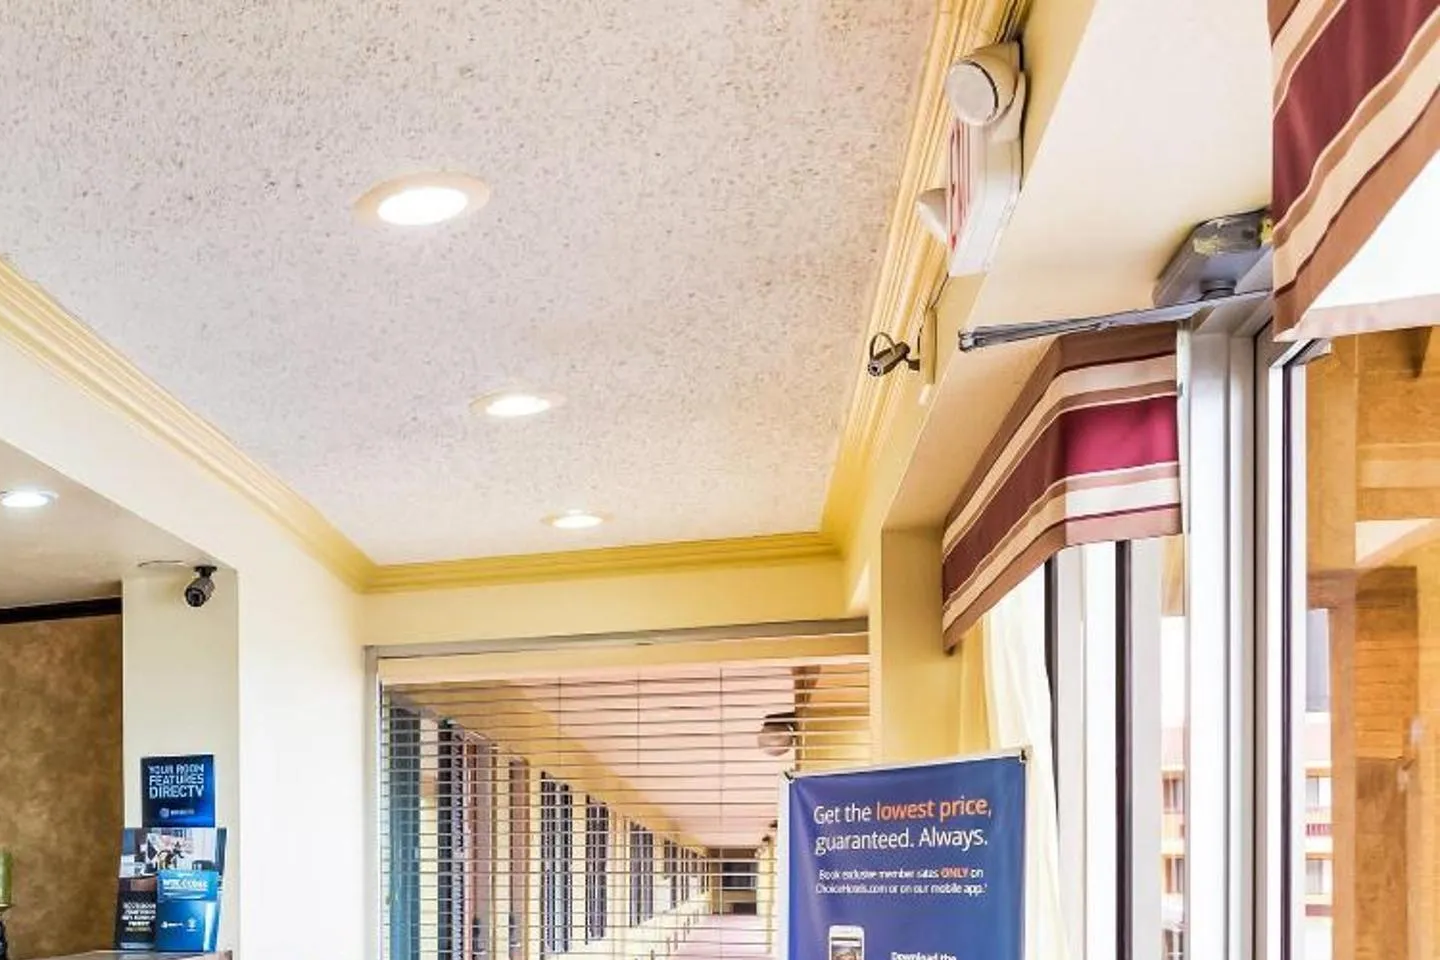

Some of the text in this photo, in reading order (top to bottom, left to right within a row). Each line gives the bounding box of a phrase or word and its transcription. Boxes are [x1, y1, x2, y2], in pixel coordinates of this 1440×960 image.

[148, 764, 174, 775] YOUR
[148, 773, 205, 786] FEATURES
[149, 784, 205, 799] DIRECTV
[813, 795, 992, 824] Get the lowest price,
[814, 825, 988, 855] guaranteed. Always.
[819, 868, 840, 880] Book
[878, 867, 916, 879] member
[940, 867, 970, 878] ONLY
[969, 868, 984, 878] on
[888, 885, 899, 894] or
[900, 884, 912, 894] on
[913, 884, 929, 894] our
[930, 883, 962, 894] mobile
